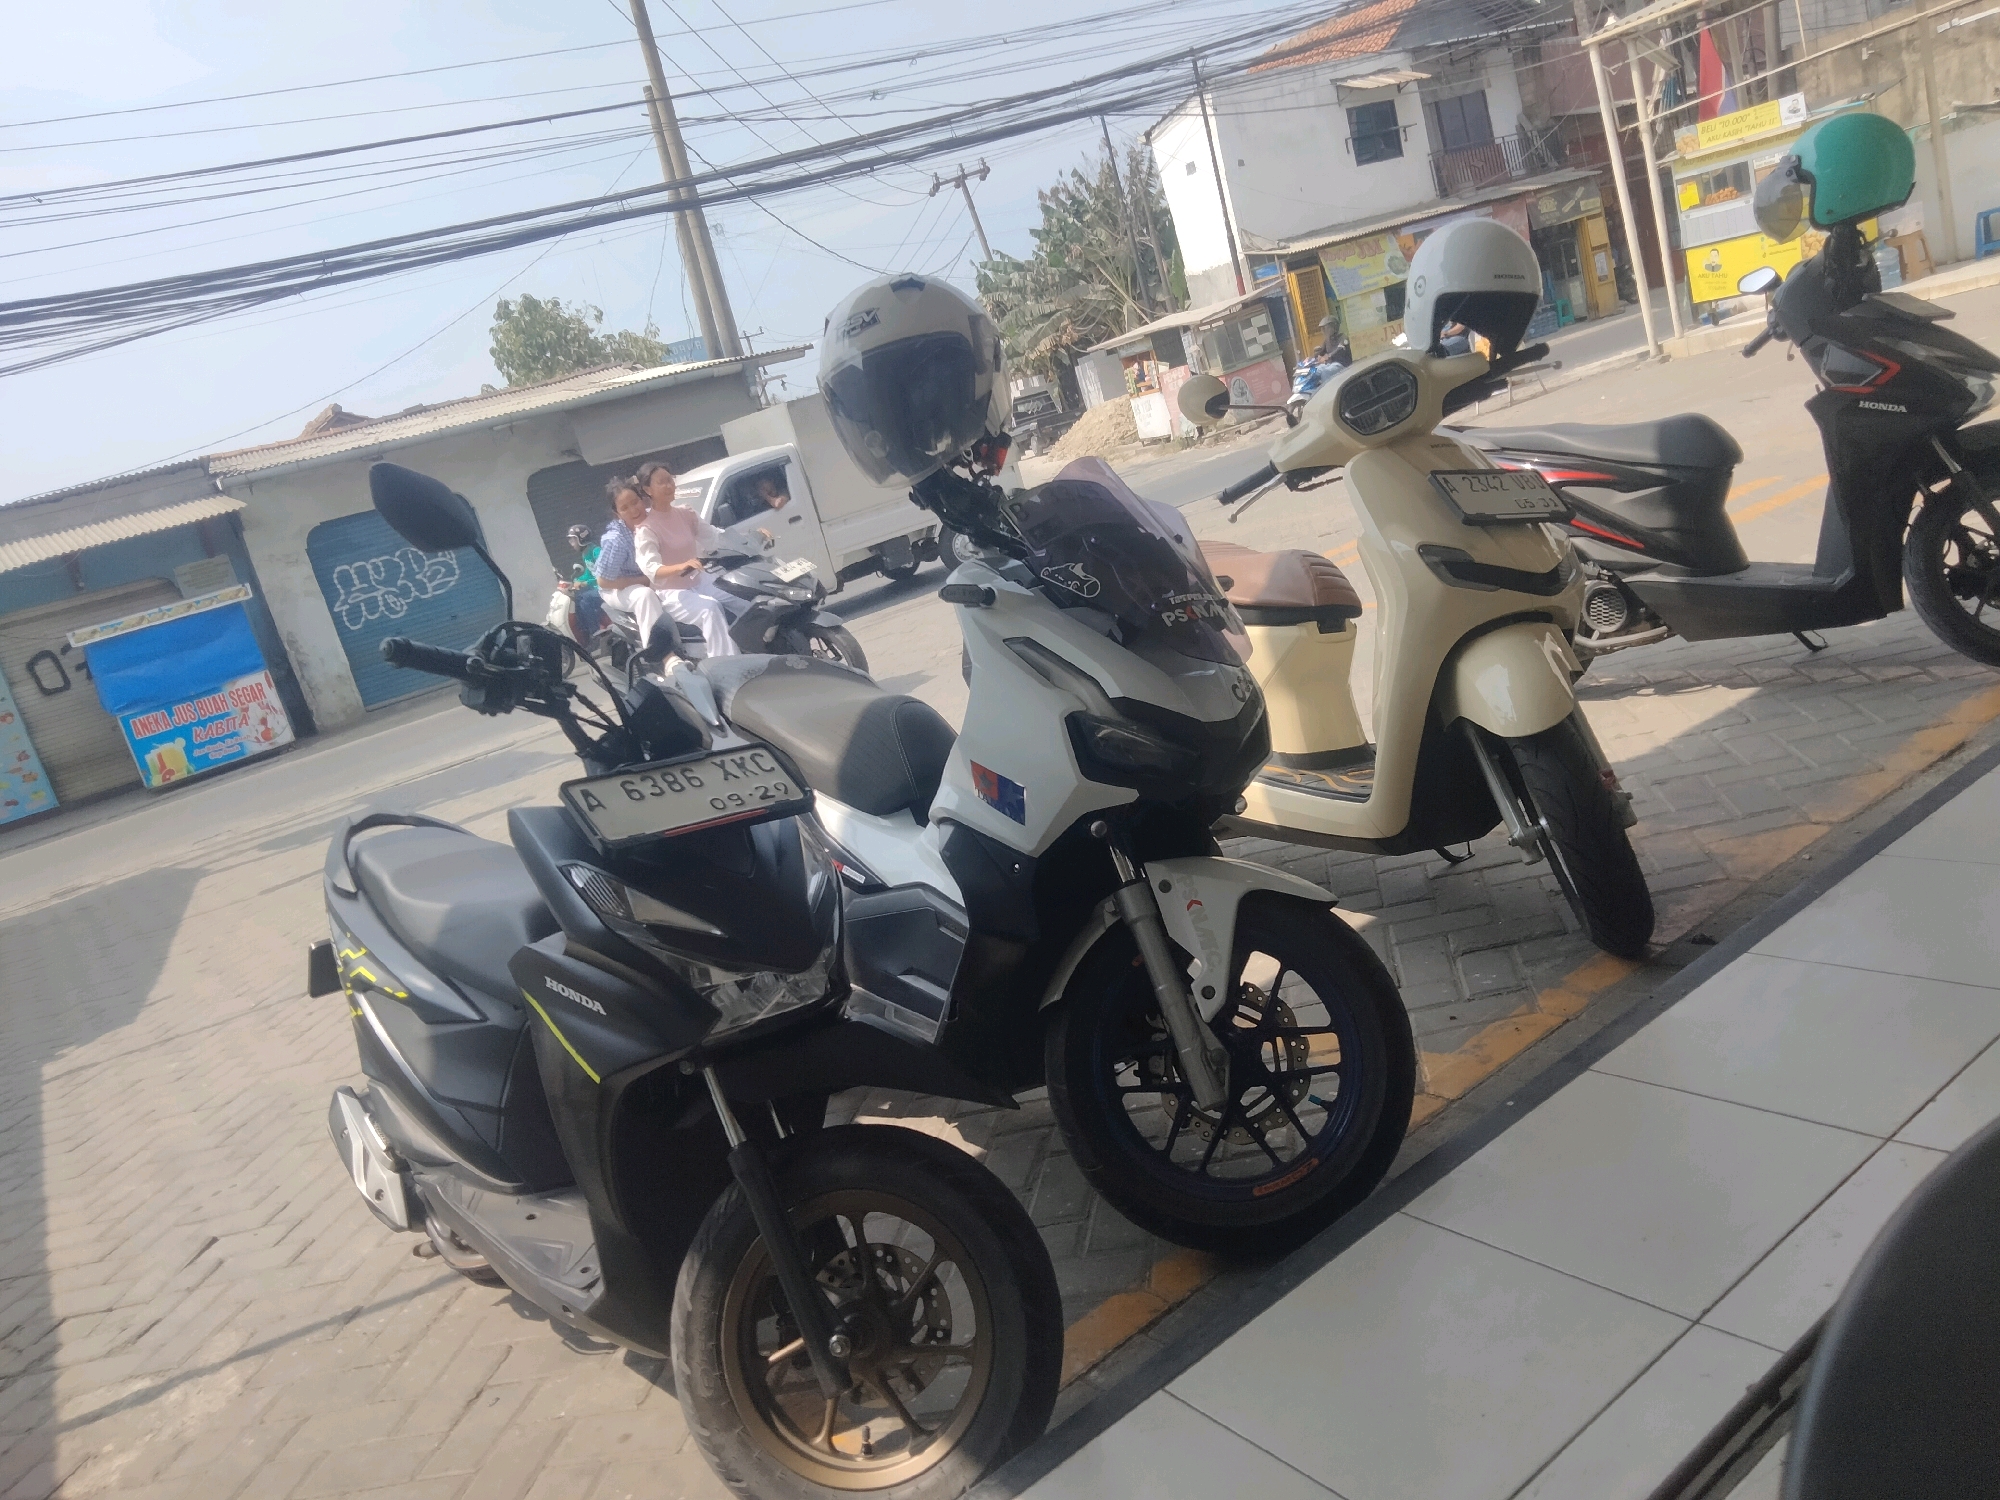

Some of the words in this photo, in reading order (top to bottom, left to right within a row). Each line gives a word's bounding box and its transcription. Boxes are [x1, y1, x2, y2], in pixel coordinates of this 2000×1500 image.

[1701, 123, 1717, 135] BELI
[1706, 134, 1722, 143] AKU
[1723, 127, 1743, 138] KASIH
[1859, 400, 1908, 413] HONDA
[1443, 477, 1459, 495] A
[1462, 476, 1509, 493] 2342
[130, 710, 172, 739] ANEKA
[173, 702, 197, 726] JUS
[195, 693, 230, 719] BUAH
[228, 682, 267, 708] SEGAR
[579, 788, 607, 812] A
[619, 767, 705, 801] 6386
[544, 975, 608, 1016] HONDA
